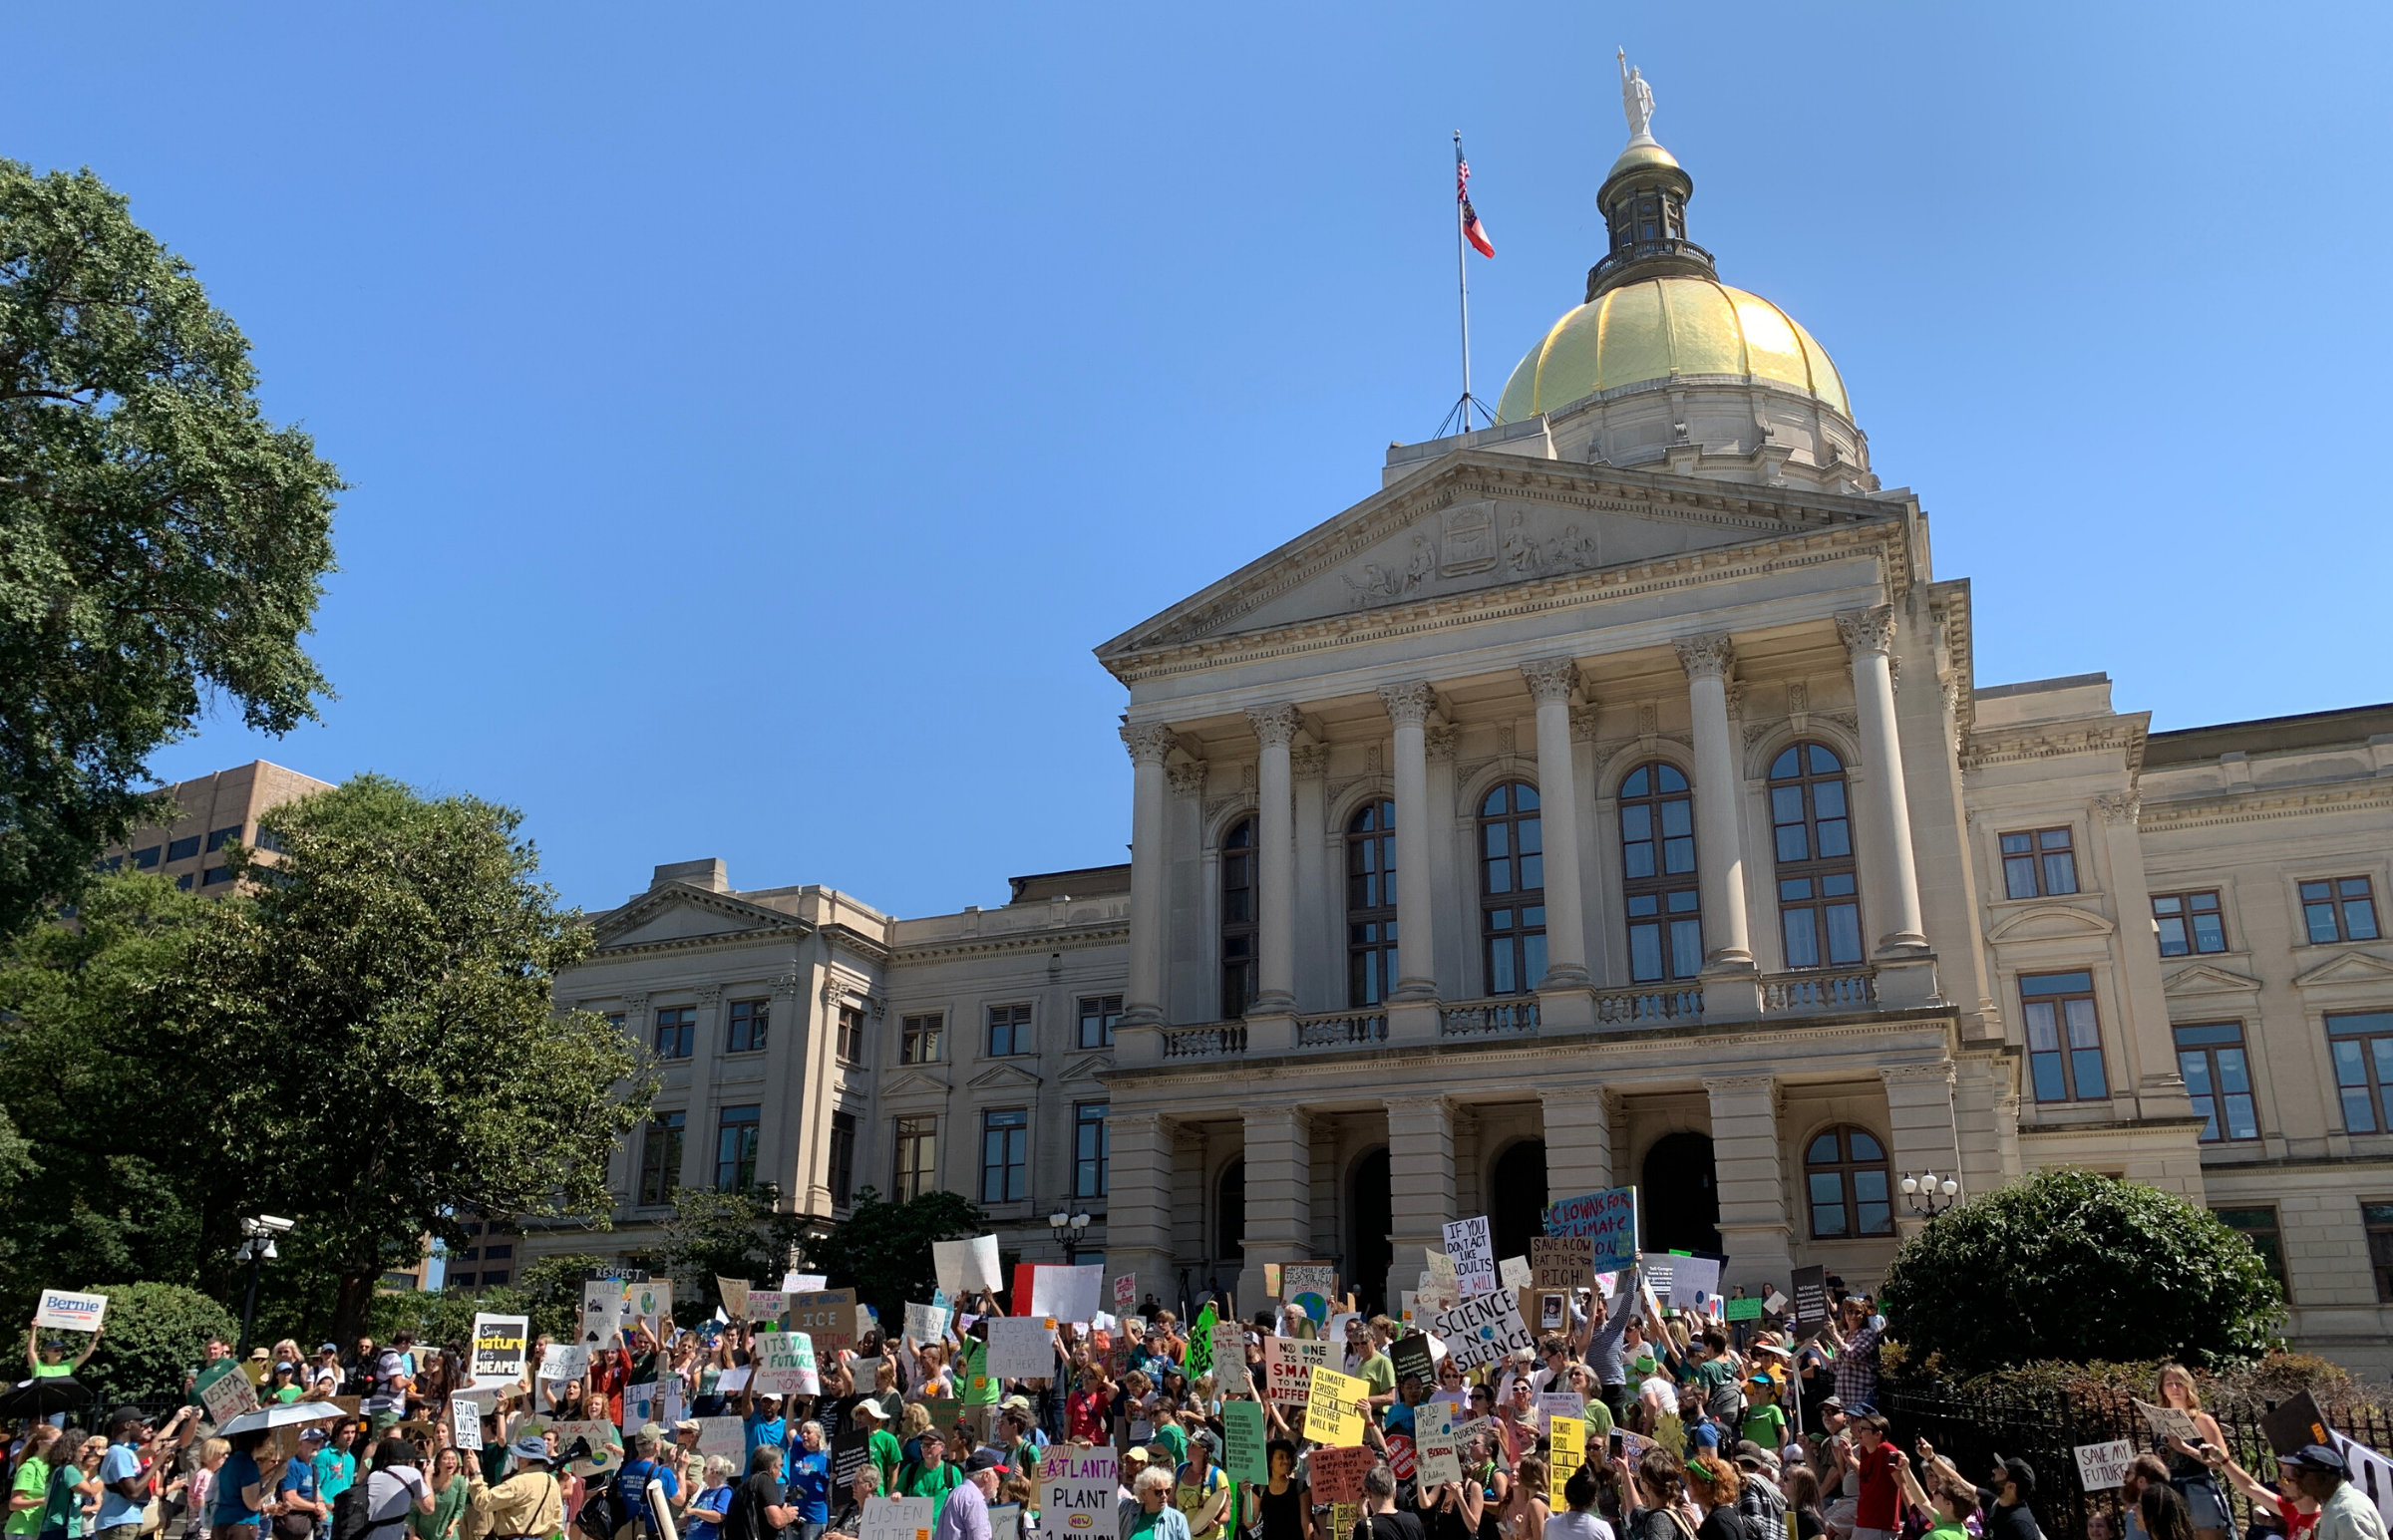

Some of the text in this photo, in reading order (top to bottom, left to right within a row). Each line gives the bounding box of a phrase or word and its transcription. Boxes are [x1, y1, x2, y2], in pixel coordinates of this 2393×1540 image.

[1551, 1192, 1631, 1225] CLOWNS FOR
[1448, 1219, 1485, 1240] IF YOU
[1471, 1235, 1486, 1248] ACT
[1534, 1238, 1559, 1252] SAVE
[1562, 1238, 1569, 1251] A
[1570, 1238, 1591, 1252] COW
[1460, 1249, 1477, 1261] LIKE
[1534, 1254, 1575, 1266] EAT THE
[596, 1268, 643, 1281] RESPECT
[1295, 1272, 1315, 1281] SCHOOL
[1504, 1265, 1521, 1277] OUR
[1541, 1269, 1582, 1286] RICH!
[1472, 1274, 1493, 1291] WILL
[46, 1296, 100, 1313] Bernie
[750, 1293, 784, 1302] DENIAL
[794, 1295, 814, 1307] THE
[1435, 1290, 1516, 1338] SCIENCE
[482, 1326, 506, 1336] Save
[992, 1320, 1042, 1334] I COULD
[1212, 1328, 1217, 1337] I
[475, 1336, 527, 1351] nature
[764, 1334, 787, 1353] IT'S
[993, 1333, 1046, 1345] HAVE GONE
[1212, 1339, 1242, 1350] The Trees
[481, 1351, 496, 1361] it's
[1004, 1343, 1032, 1357] AREA
[1455, 1329, 1533, 1373] SILENCE
[770, 1353, 815, 1370] FUTURE
[994, 1358, 1037, 1373] BUT HERE
[1189, 1349, 1213, 1380] MEA
[1303, 1356, 1323, 1366] TOO
[543, 1363, 586, 1377] REZPECT
[777, 1378, 806, 1390] NOW
[1316, 1370, 1346, 1387] CLIMATE
[625, 1385, 642, 1405] HER
[1314, 1381, 1339, 1397] CRISIS
[455, 1401, 480, 1417] STAND
[1313, 1393, 1337, 1411] WON'T
[1311, 1404, 1341, 1423] NEITHER
[1415, 1404, 1439, 1419] WE DO
[458, 1417, 479, 1433] WITH
[569, 1422, 601, 1434] BE A
[1309, 1415, 1326, 1430] WILL
[1423, 1415, 1437, 1427] NOT
[1552, 1420, 1570, 1435] CLIMATE
[1453, 1420, 1488, 1441] TUDENTS
[1625, 1433, 1639, 1442] MY
[457, 1433, 483, 1449] GRETA
[1387, 1439, 1403, 1456] TOP
[1427, 1446, 1453, 1458] BORROW
[2081, 1443, 2128, 1466] SAVE MY
[1047, 1458, 1119, 1479] ATLANTA
[1552, 1466, 1571, 1481] NEITHER
[1053, 1487, 1108, 1509] PLANT
[868, 1504, 923, 1525] LISTEN
[892, 1527, 915, 1540] THE
